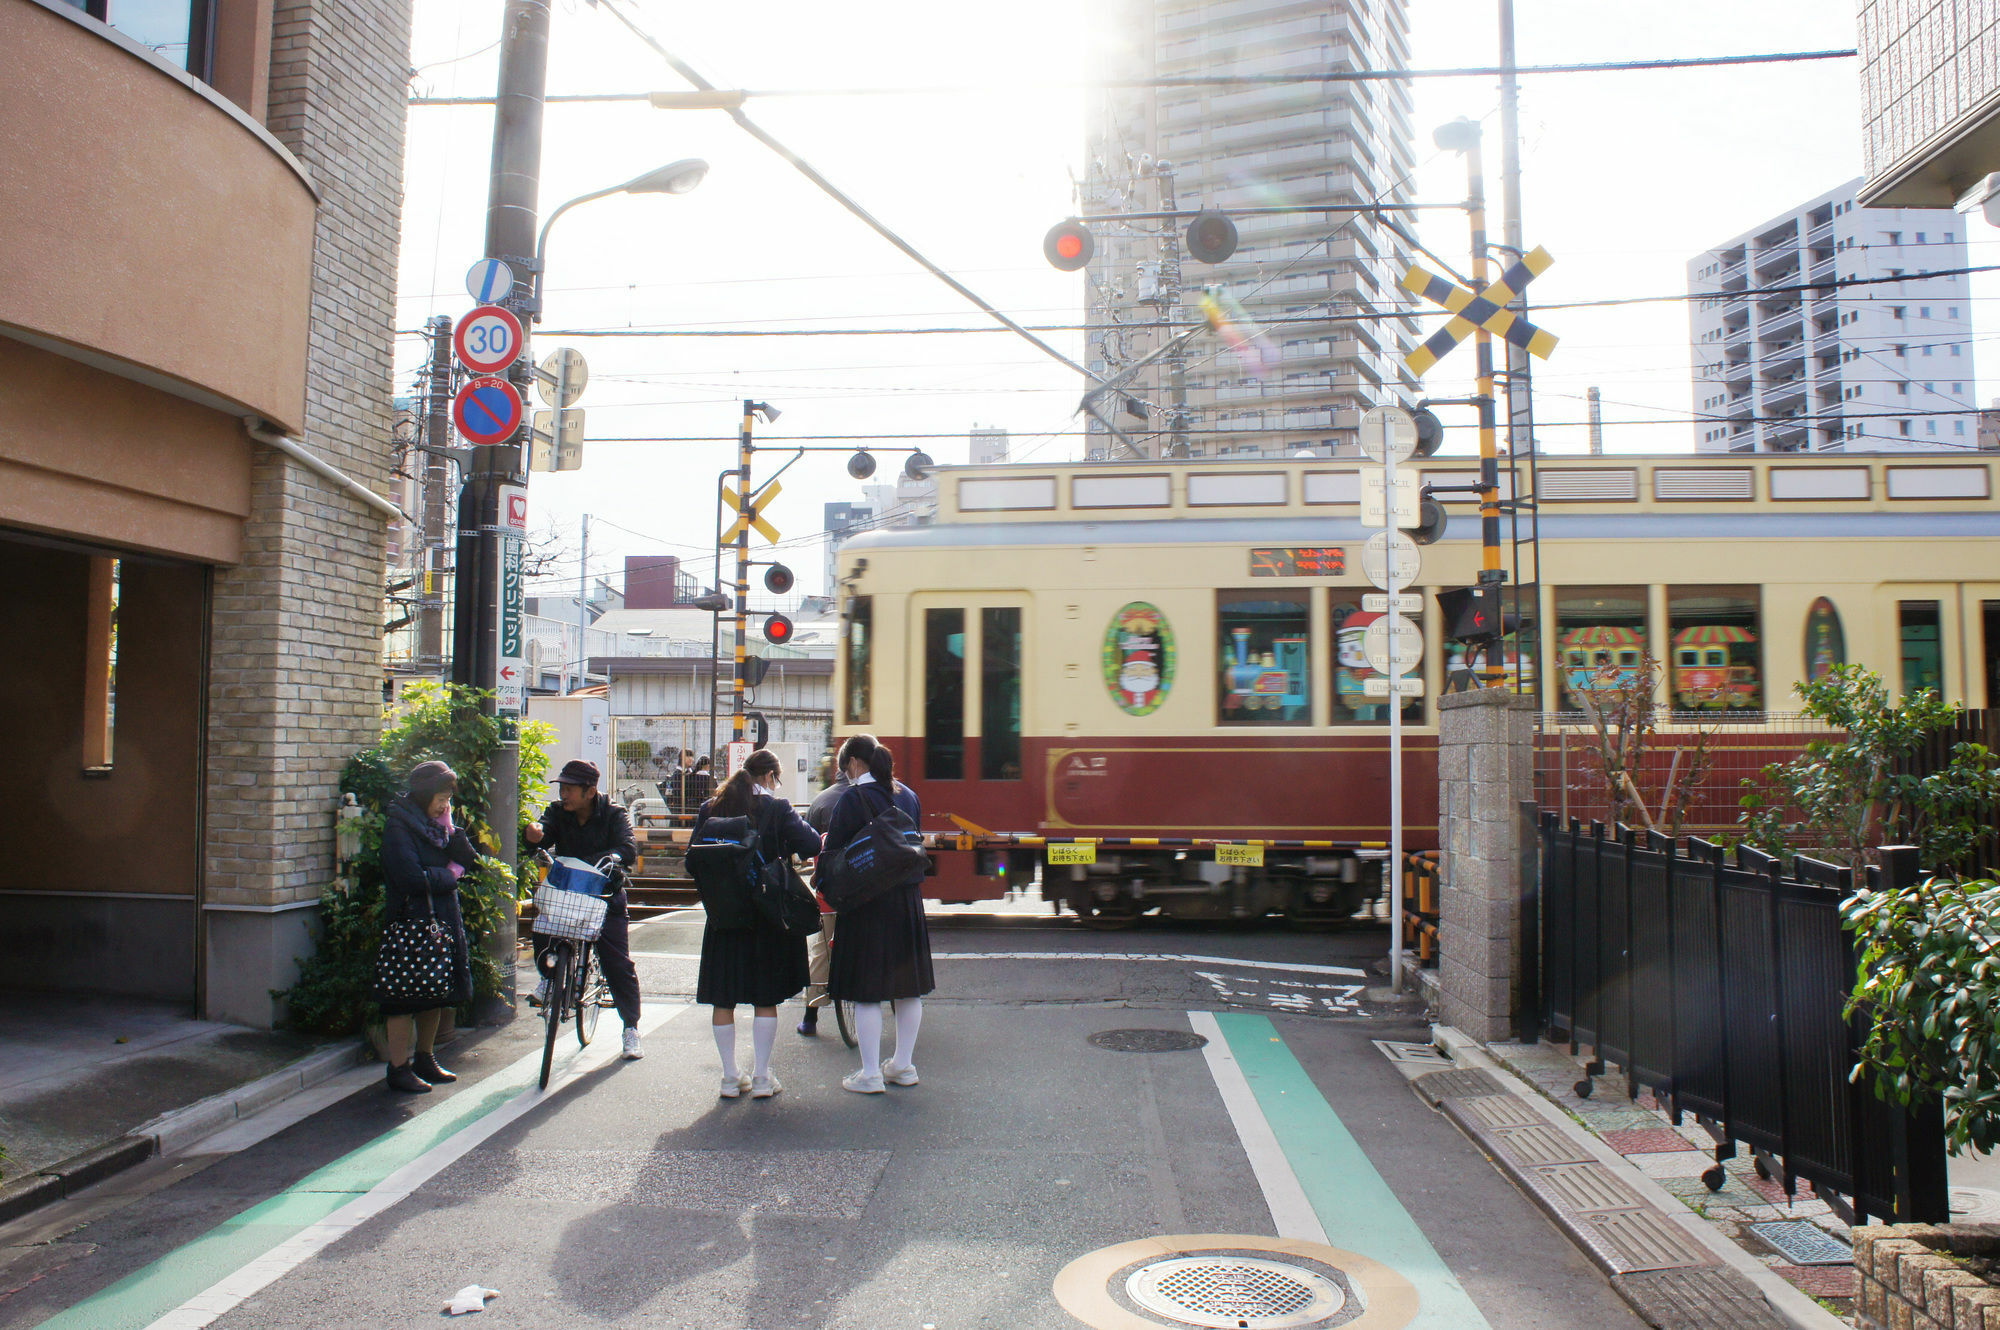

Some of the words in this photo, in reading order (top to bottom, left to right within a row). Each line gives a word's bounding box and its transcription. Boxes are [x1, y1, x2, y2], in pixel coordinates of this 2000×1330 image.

[470, 325, 507, 354] 30
[1052, 847, 1078, 855] しばらく
[1219, 848, 1246, 856] しばらく
[1052, 854, 1093, 863] お待ち下さい
[1219, 855, 1260, 865] お待ち下さい
